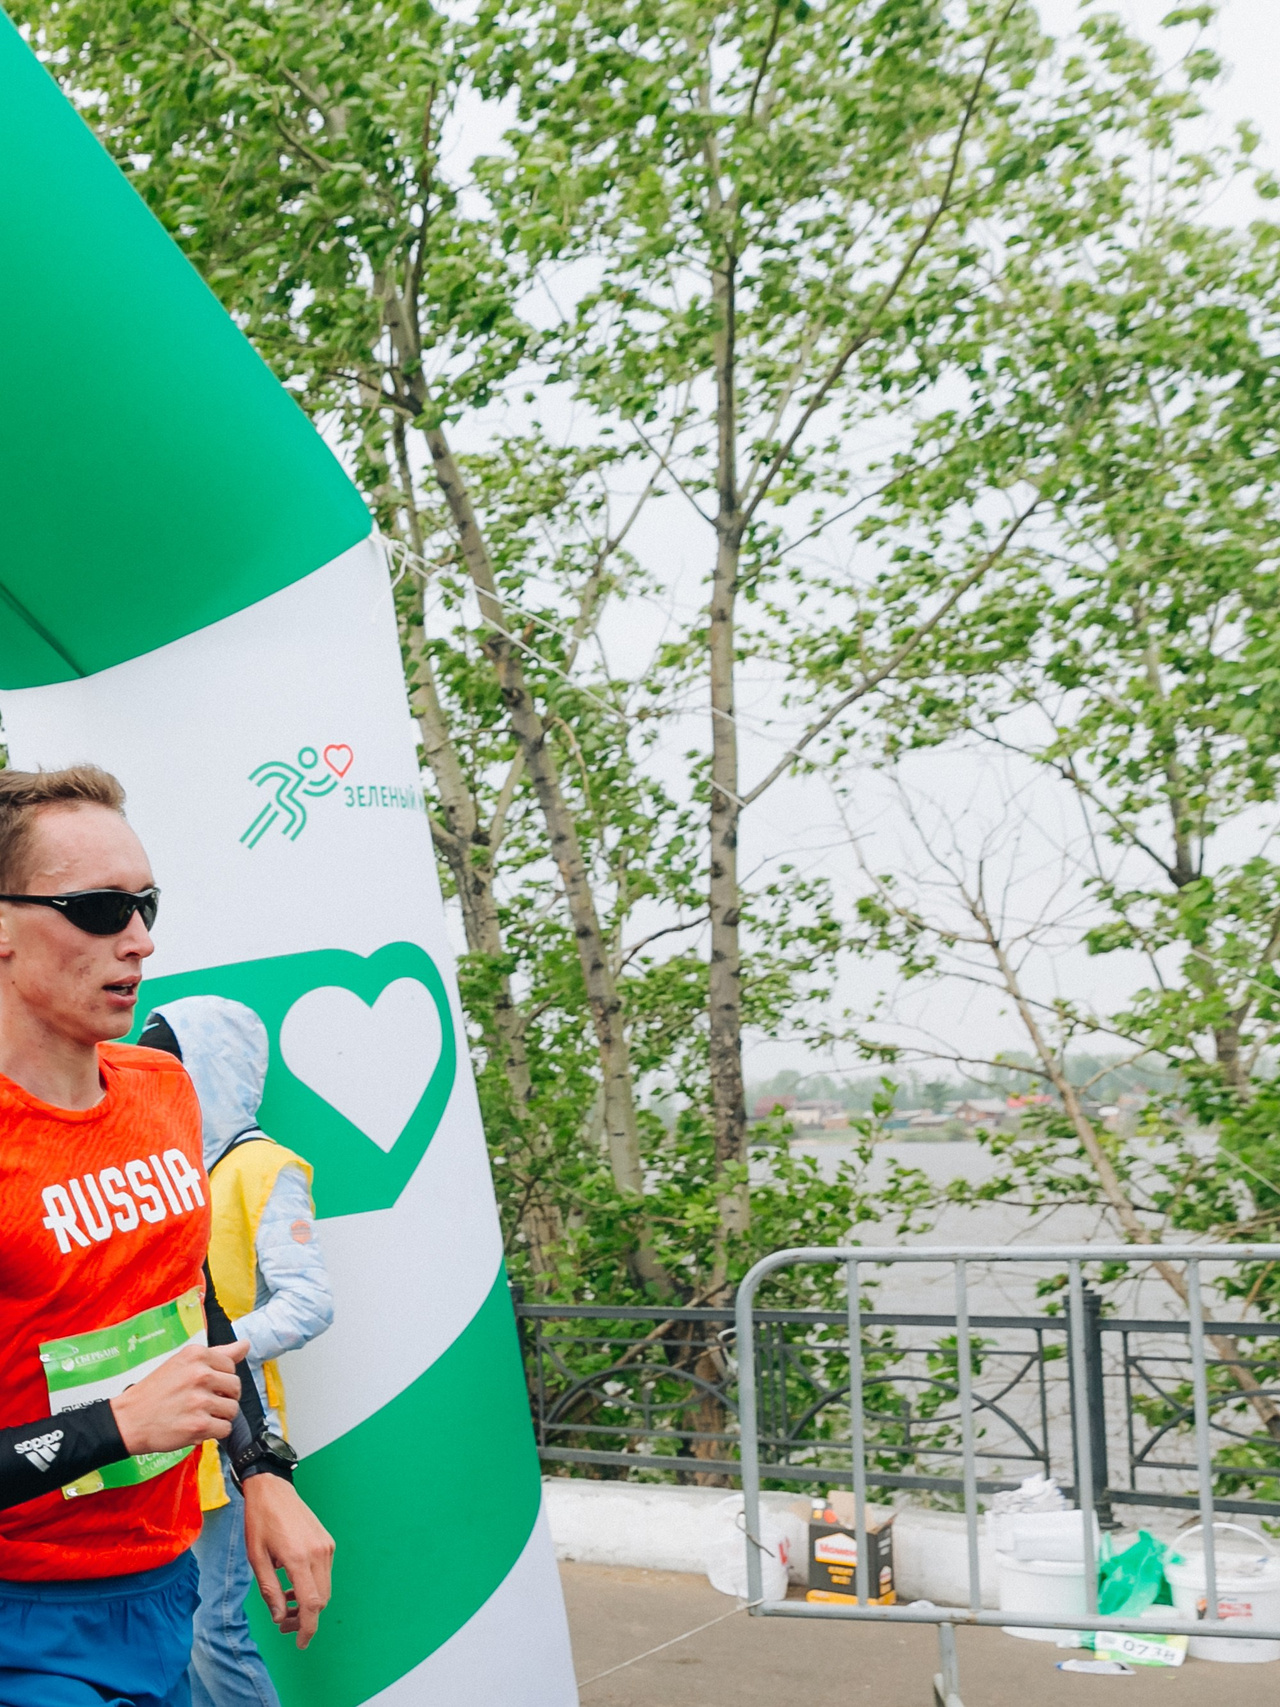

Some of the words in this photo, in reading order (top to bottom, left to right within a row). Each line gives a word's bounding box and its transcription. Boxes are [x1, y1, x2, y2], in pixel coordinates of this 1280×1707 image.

[343, 784, 417, 810] ЗЕЛЕНЫЙ
[41, 1148, 206, 1254] RUSSIA
[14, 1430, 64, 1454] adidas
